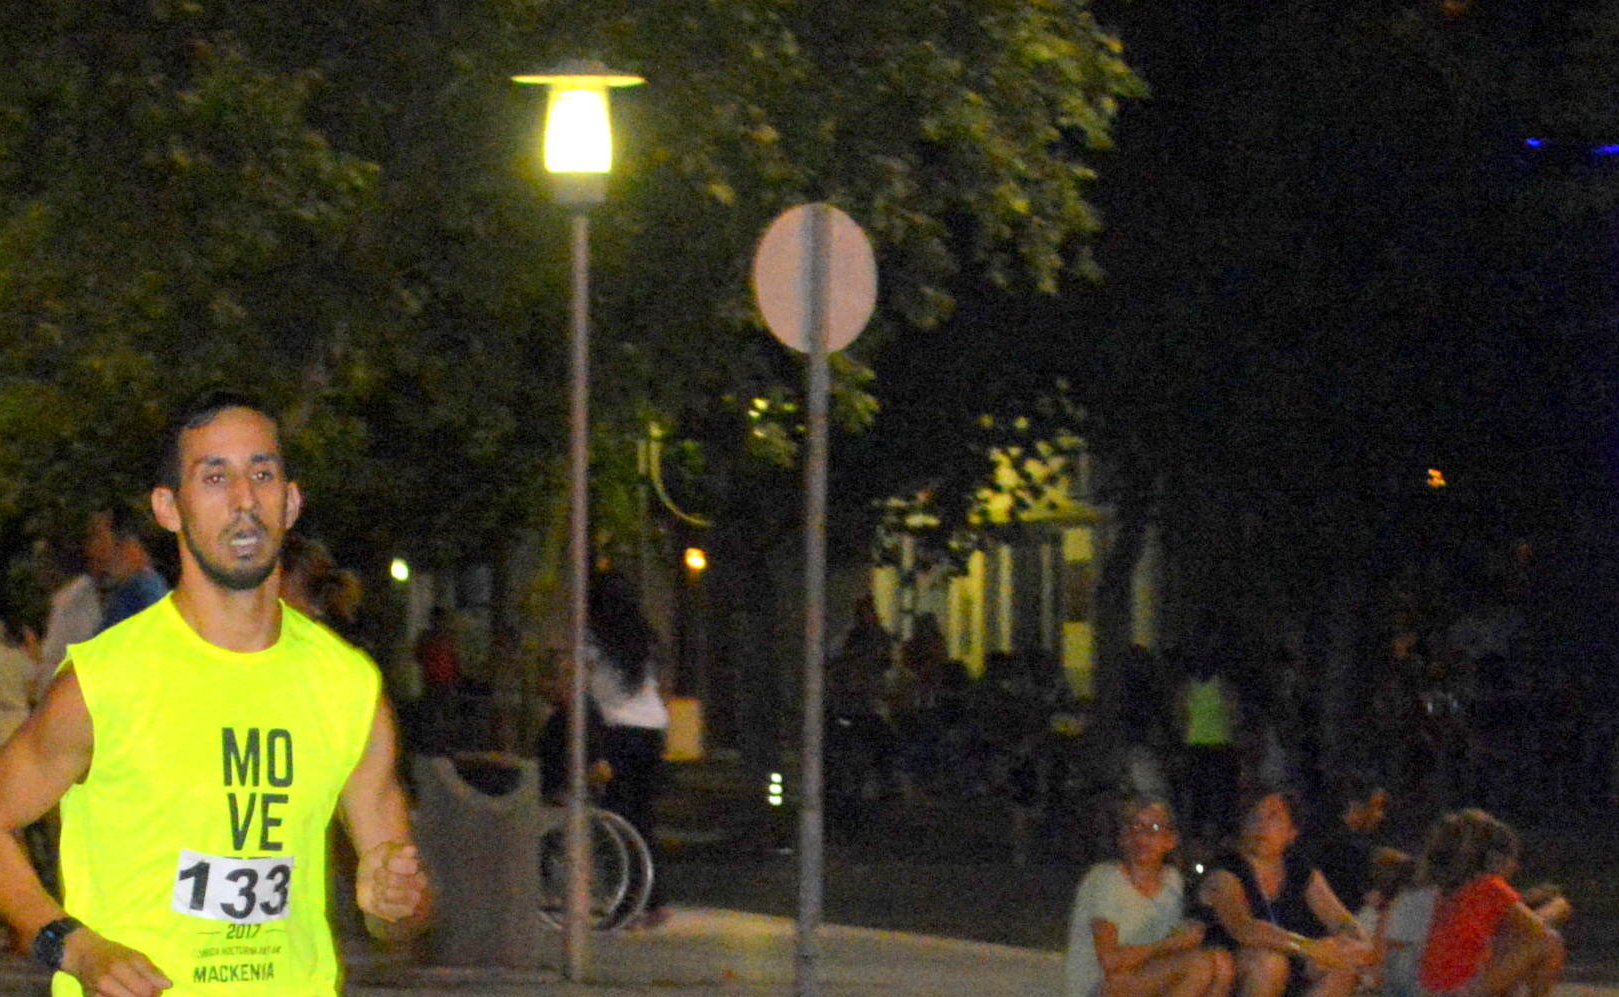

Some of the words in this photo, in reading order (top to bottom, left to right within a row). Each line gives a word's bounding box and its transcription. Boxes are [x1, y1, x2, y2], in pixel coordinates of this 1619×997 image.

[221, 727, 294, 788] MO
[227, 792, 289, 852] VE
[178, 861, 292, 920] 133
[225, 923, 261, 940] 2017
